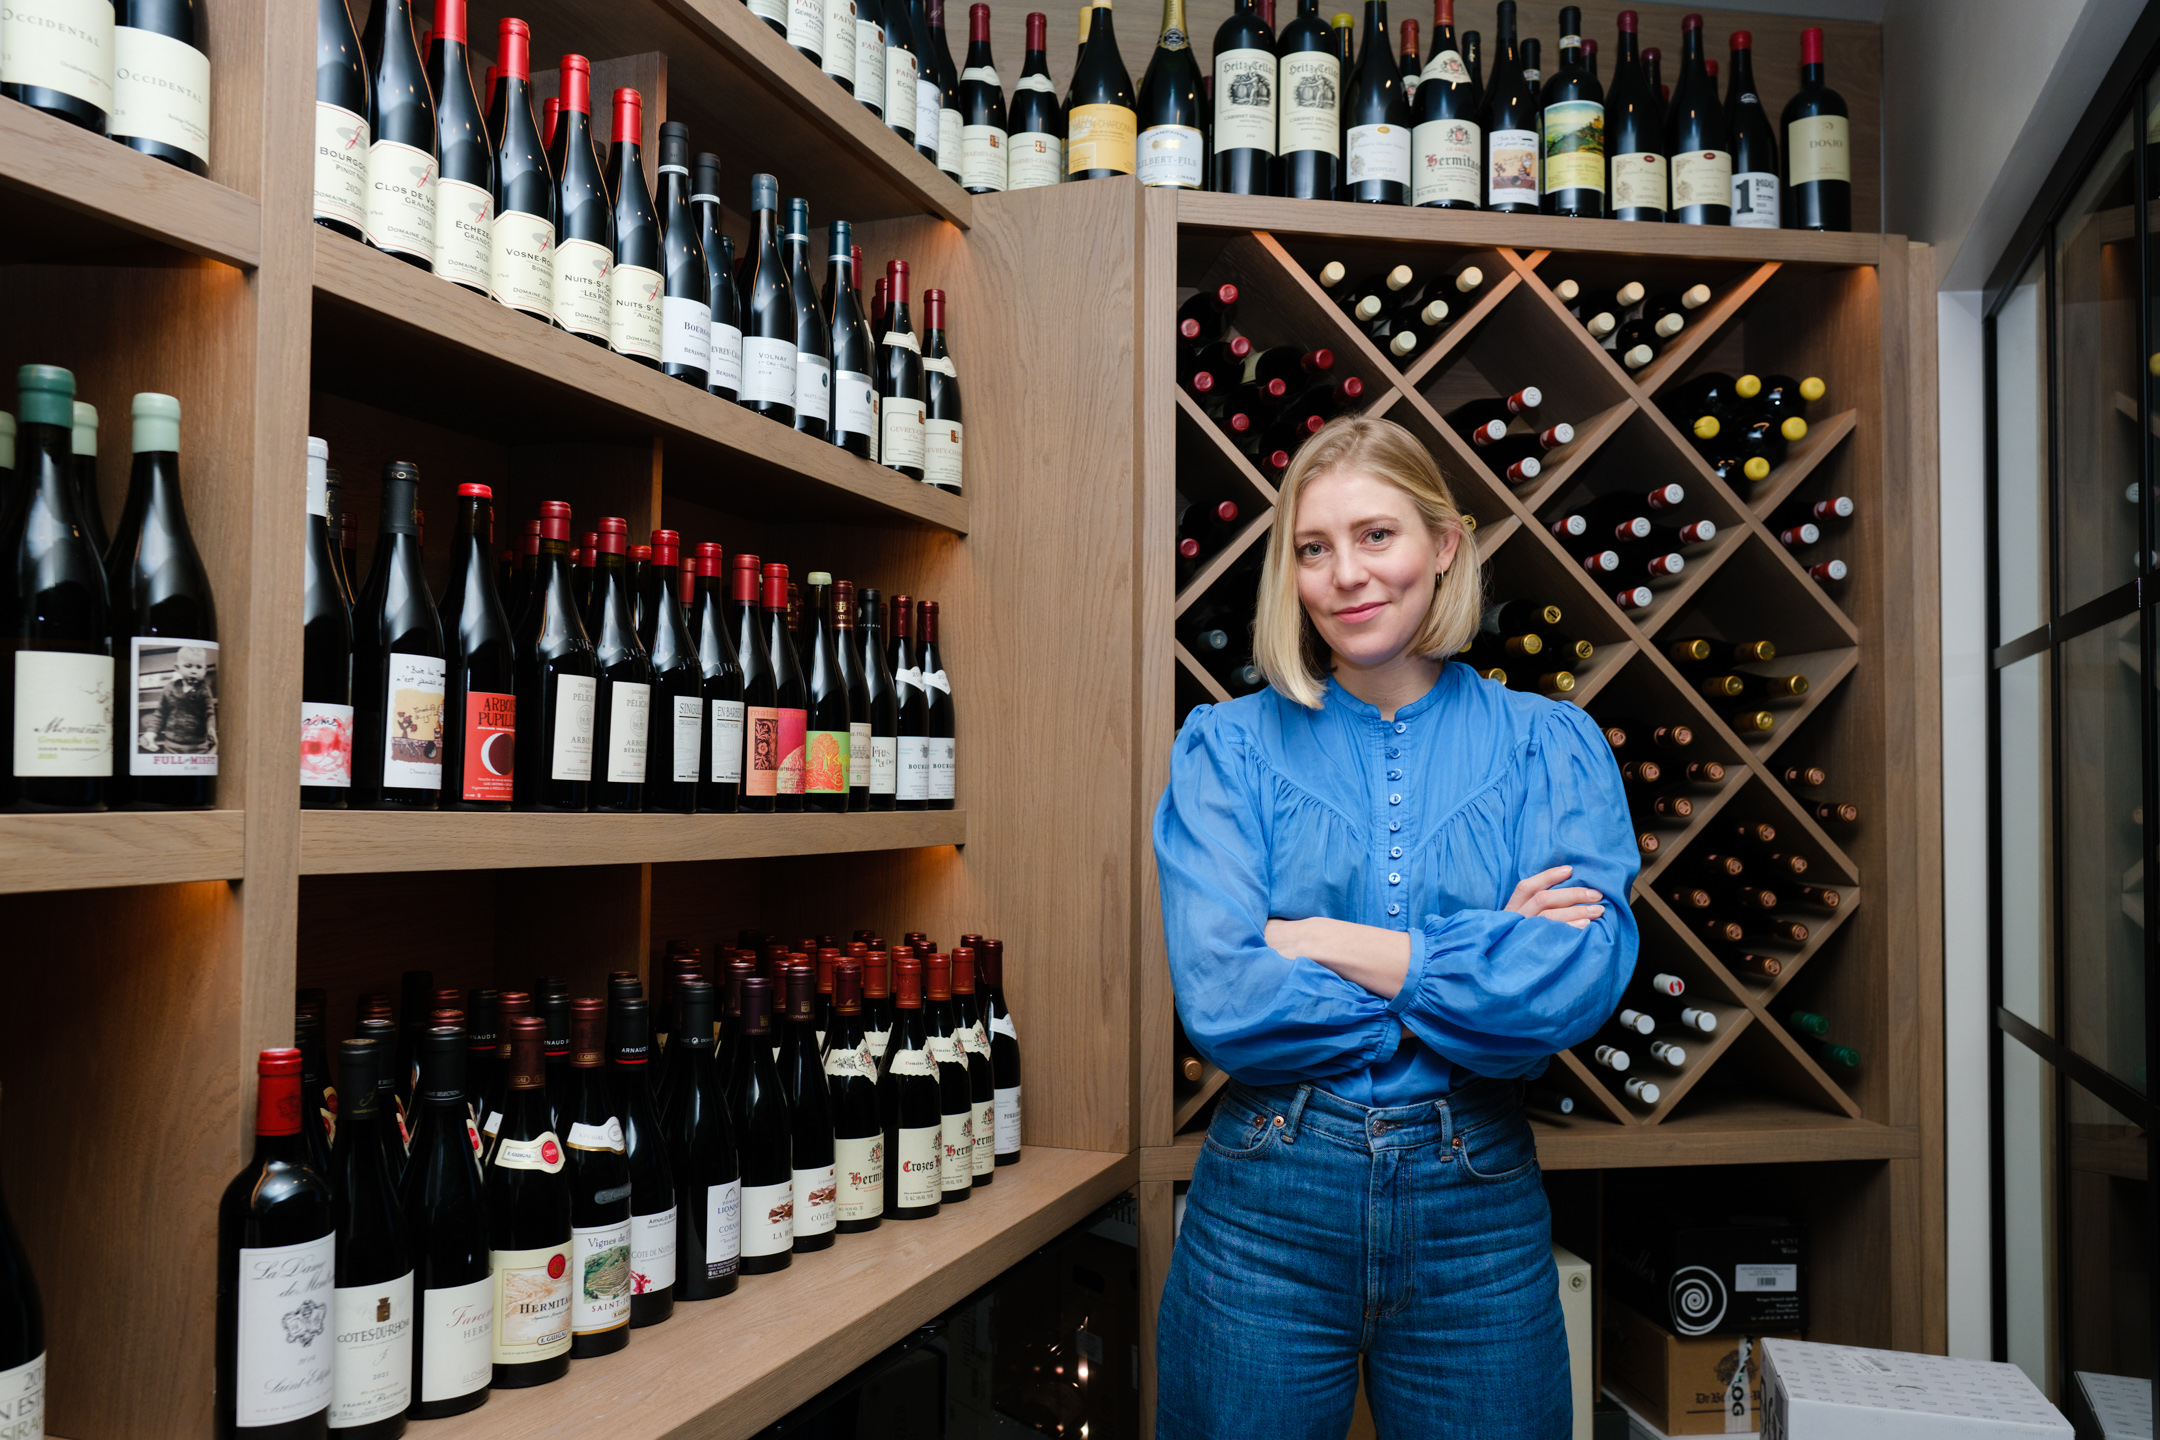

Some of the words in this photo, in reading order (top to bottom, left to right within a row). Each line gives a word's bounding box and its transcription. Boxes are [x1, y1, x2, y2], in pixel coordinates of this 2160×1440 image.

[117, 68, 203, 104] OCCIDENTAL
[1146, 130, 1189, 141] CHAMPAGNE
[375, 182, 407, 195] CLOS
[411, 190, 423, 200] DE
[1736, 179, 1754, 214] 1
[758, 352, 787, 363] VOLNAY
[153, 756, 184, 764] FULL
[903, 1160, 934, 1173] Crozes
[588, 1236, 616, 1249] Vignes
[618, 1233, 625, 1243] de
[252, 1261, 278, 1281] La
